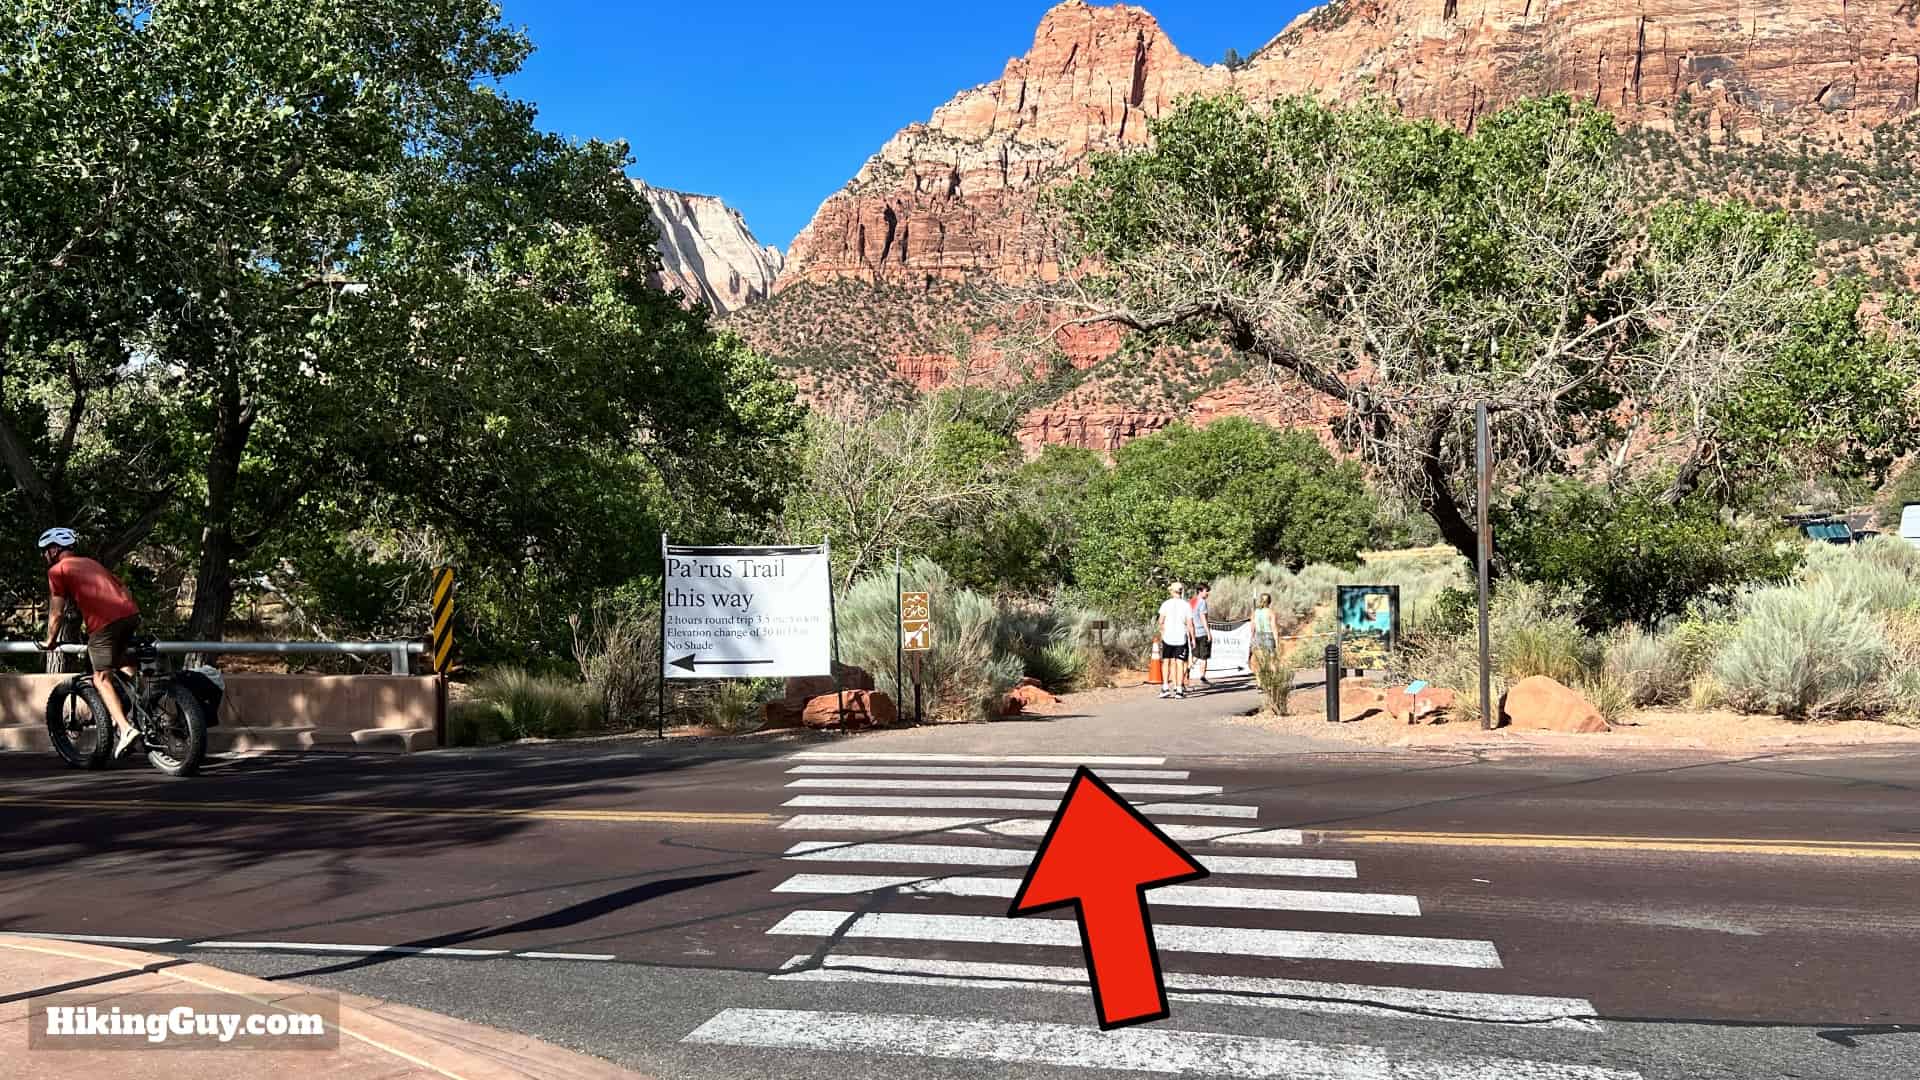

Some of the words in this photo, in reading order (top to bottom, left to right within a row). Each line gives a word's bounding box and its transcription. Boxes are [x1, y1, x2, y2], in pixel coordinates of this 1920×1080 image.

[737, 559, 785, 578] Trail
[667, 588, 705, 607] this
[712, 593, 754, 613] way
[667, 616, 673, 625] 2
[675, 615, 703, 625] hours
[705, 615, 734, 625] round
[736, 615, 754, 627] trip
[667, 628, 712, 638] Elevation
[713, 628, 748, 639] change
[749, 628, 760, 637] of
[667, 641, 682, 650] No
[684, 640, 713, 650] Shade
